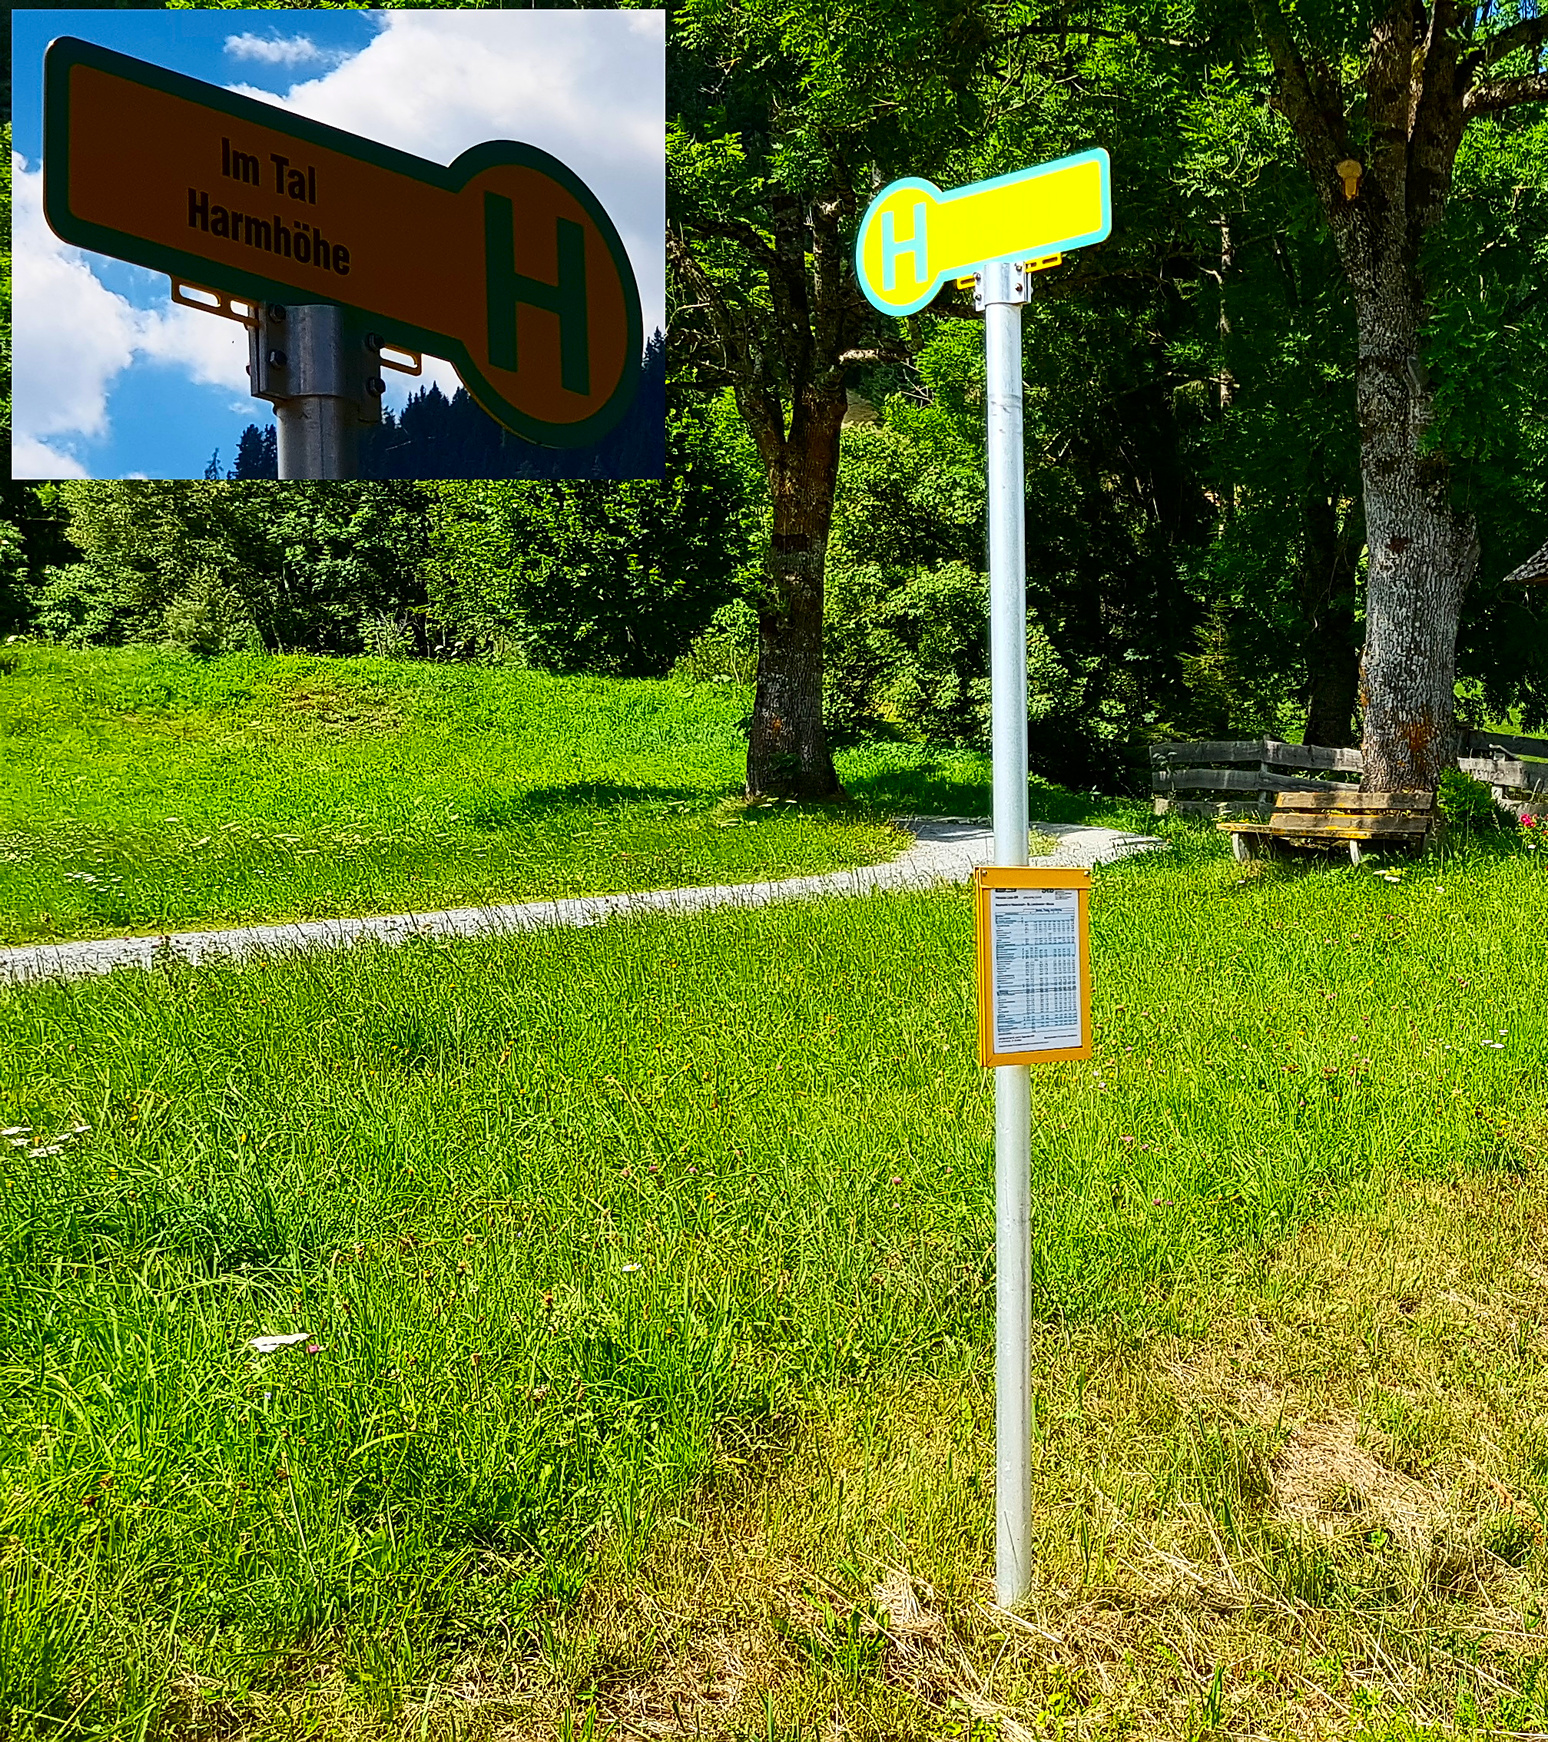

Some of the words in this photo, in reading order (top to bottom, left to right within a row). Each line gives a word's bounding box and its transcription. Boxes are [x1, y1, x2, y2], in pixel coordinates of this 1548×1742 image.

[221, 136, 260, 187] Im
[270, 153, 317, 205] Tal
[187, 187, 350, 276] Harmhöhe
[881, 202, 928, 291] H
[484, 190, 590, 396] H
